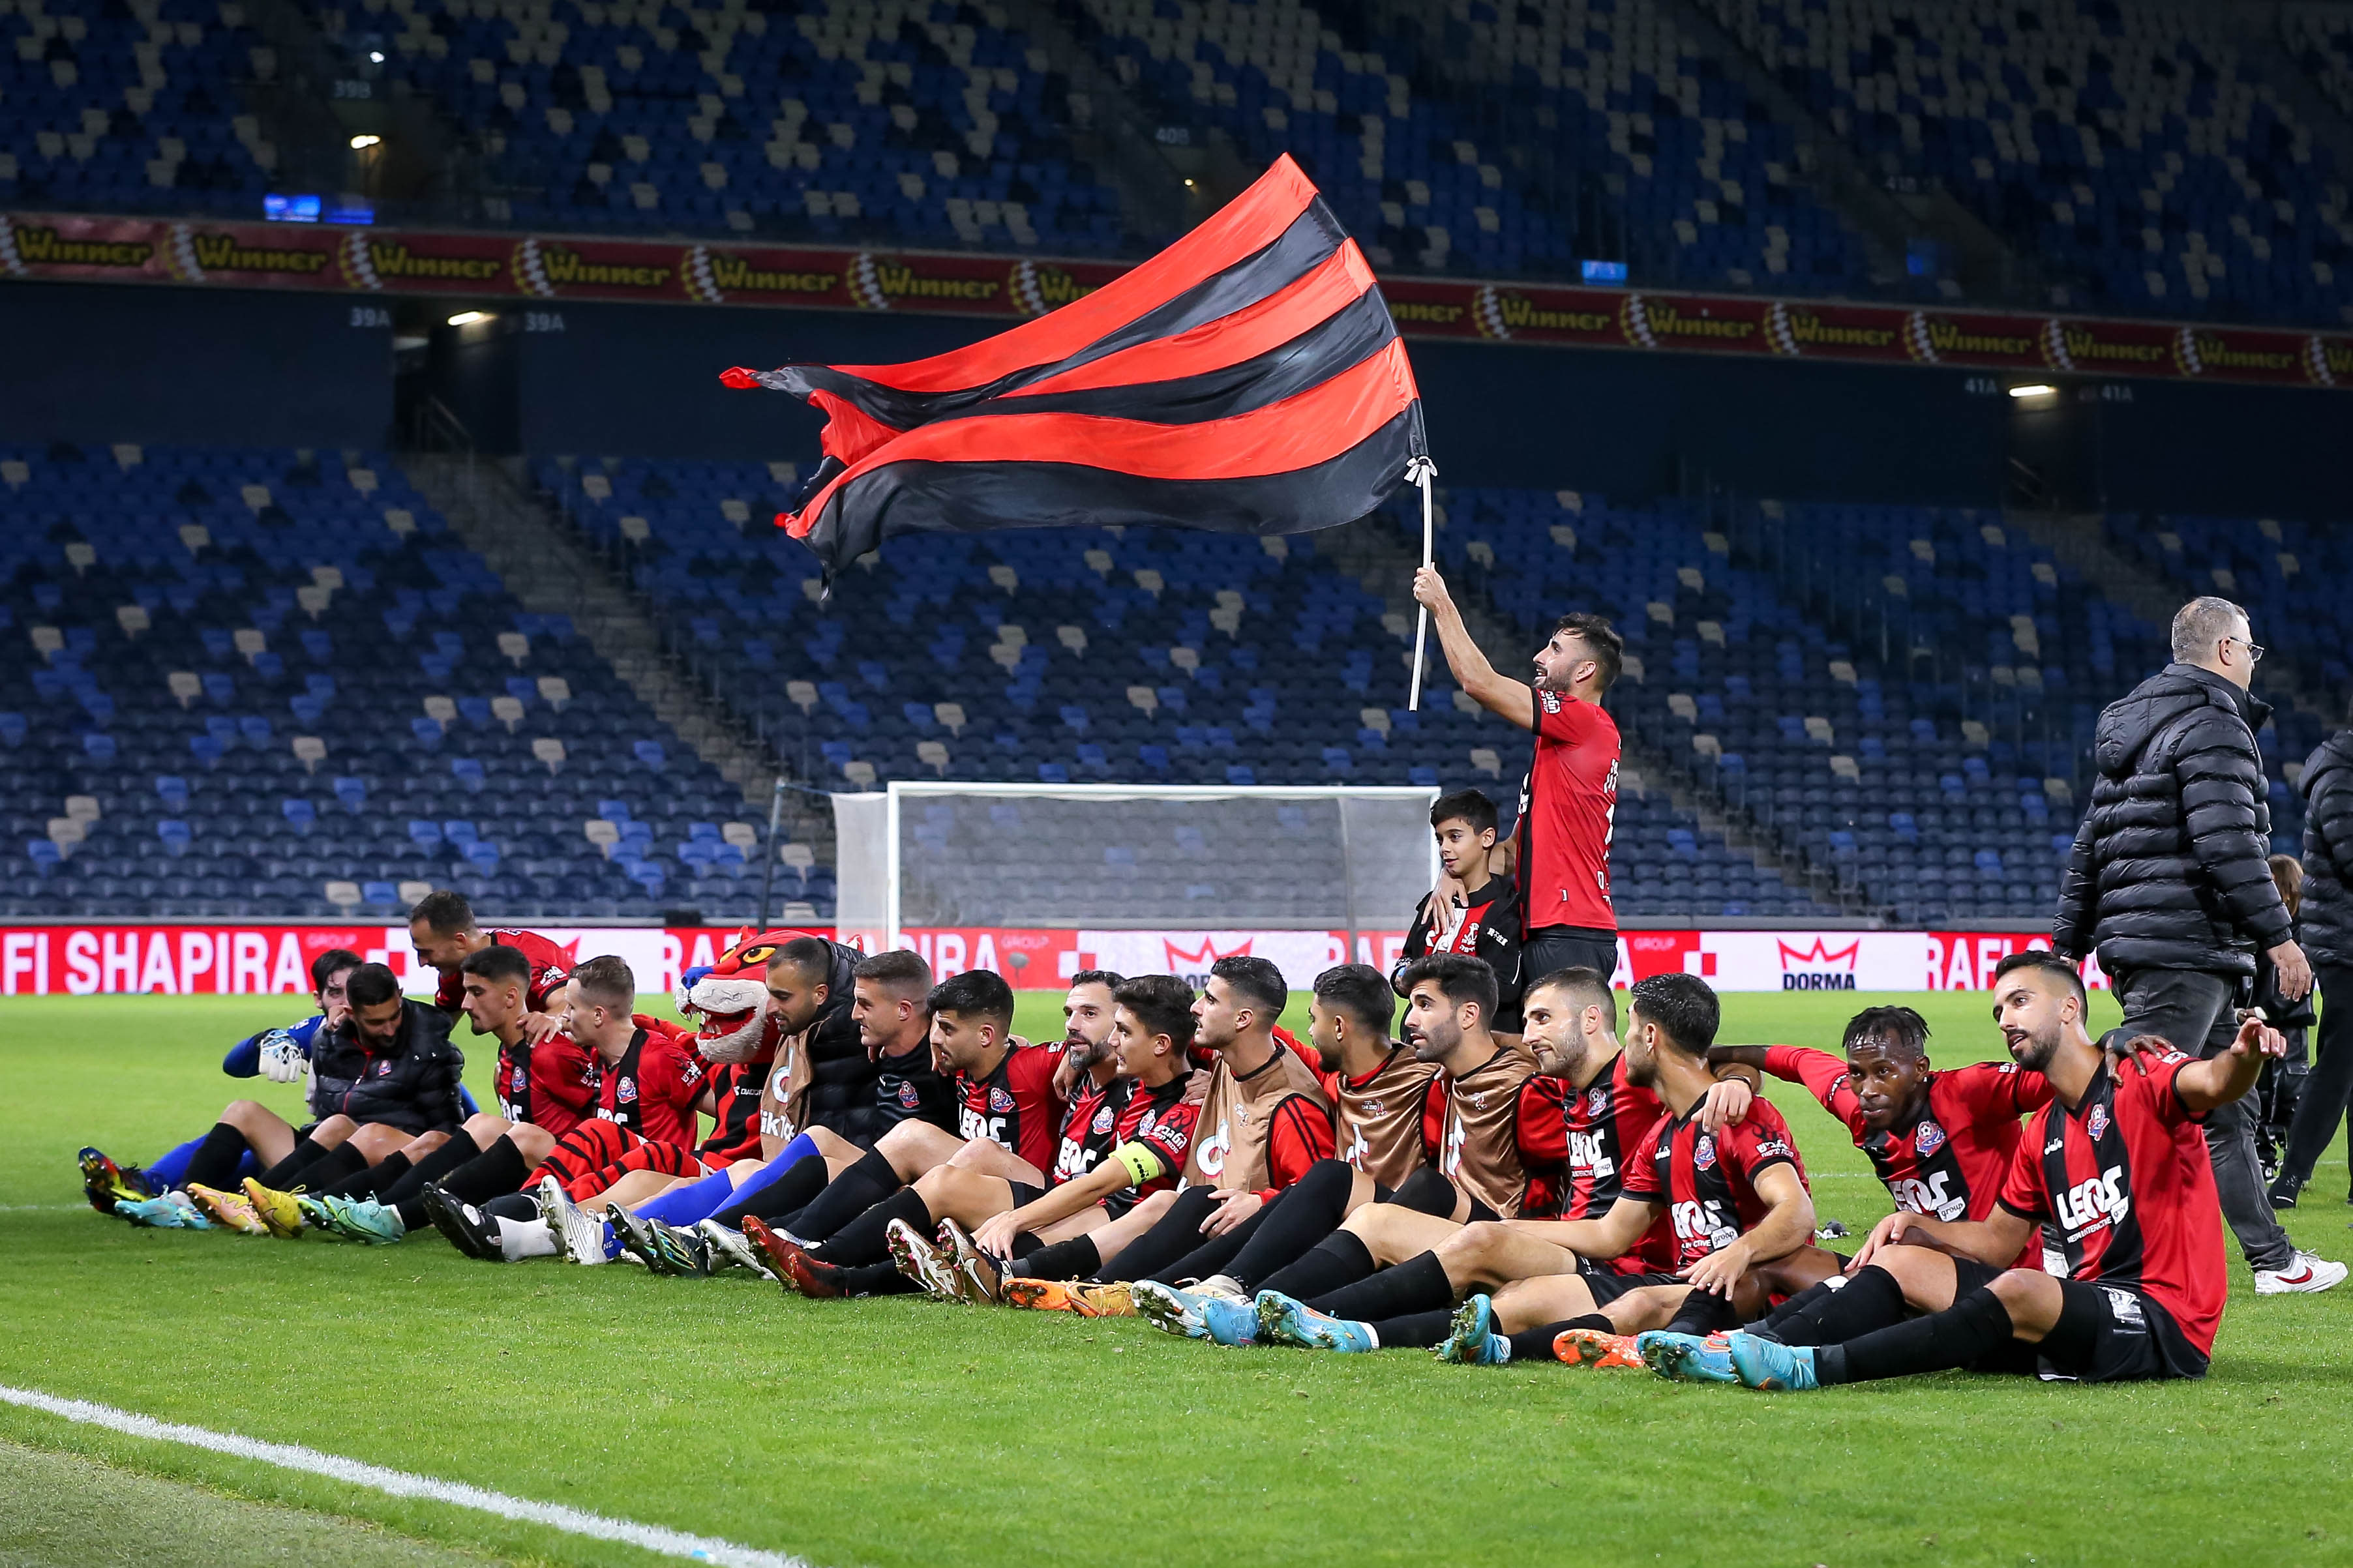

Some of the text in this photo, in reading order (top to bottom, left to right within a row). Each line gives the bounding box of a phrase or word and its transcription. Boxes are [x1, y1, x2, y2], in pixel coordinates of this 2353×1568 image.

[17, 228, 151, 262] Winner
[197, 237, 326, 271] Winner
[371, 245, 501, 279] Winner
[545, 252, 670, 286] Winner
[712, 259, 837, 293] Winner
[878, 267, 998, 299] Winner
[350, 307, 391, 327] 39A
[526, 312, 565, 333] 39A
[1501, 297, 1611, 331] Winner
[1647, 304, 1754, 338] Winner
[1791, 314, 1895, 347] Winner
[1930, 321, 2031, 355] Winner
[2066, 329, 2166, 362] Winner
[2197, 340, 2296, 369] Winner
[306, 932, 357, 949] GROUP
[3, 931, 309, 995] FI SHAPIRA
[1782, 973, 1856, 990] DORMA
[1941, 1203, 1964, 1219] group
[2056, 1164, 2123, 1230] LEOS
[1714, 1230, 1734, 1246] group
